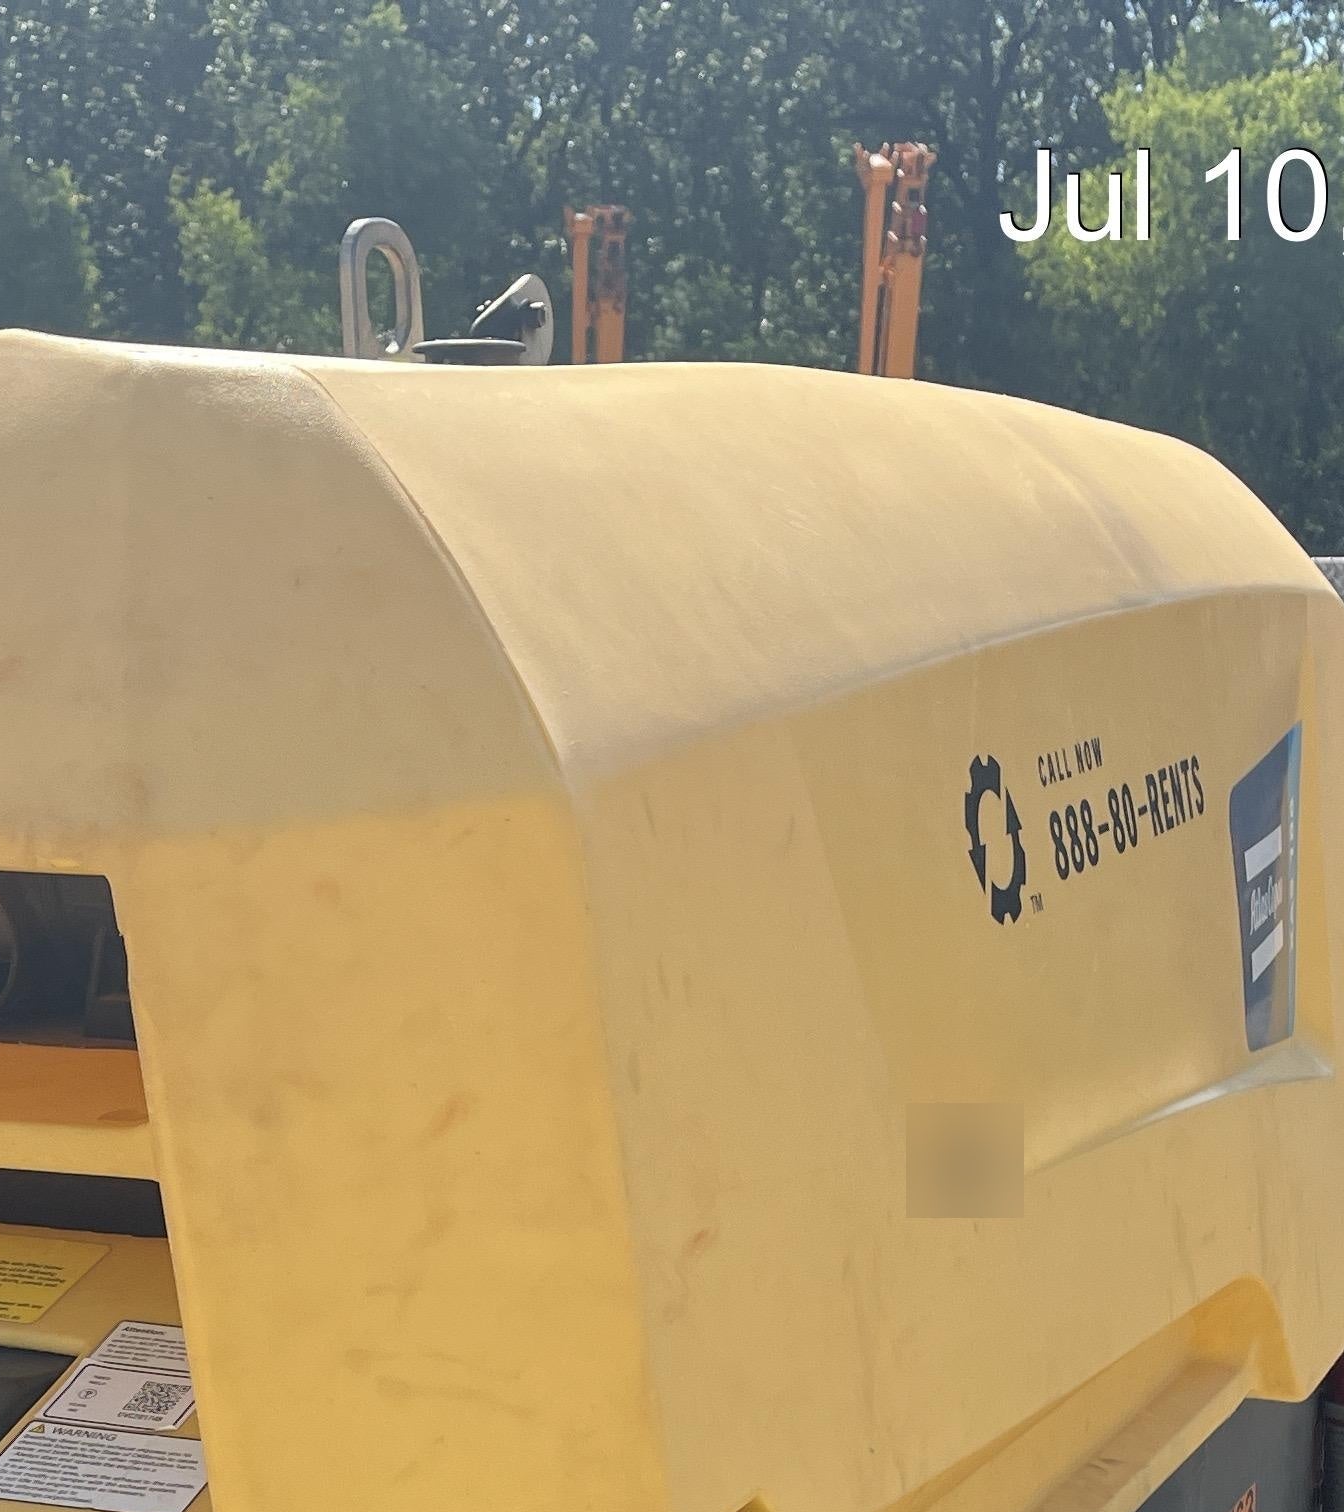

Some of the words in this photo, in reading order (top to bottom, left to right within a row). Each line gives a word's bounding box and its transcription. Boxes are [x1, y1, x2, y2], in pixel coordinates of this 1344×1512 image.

[1038, 750, 1072, 787] CALL
[1074, 737, 1104, 774] NOW
[1049, 755, 1205, 881] 888-80-RENTS
[52, 1427, 118, 1442] WARNING
